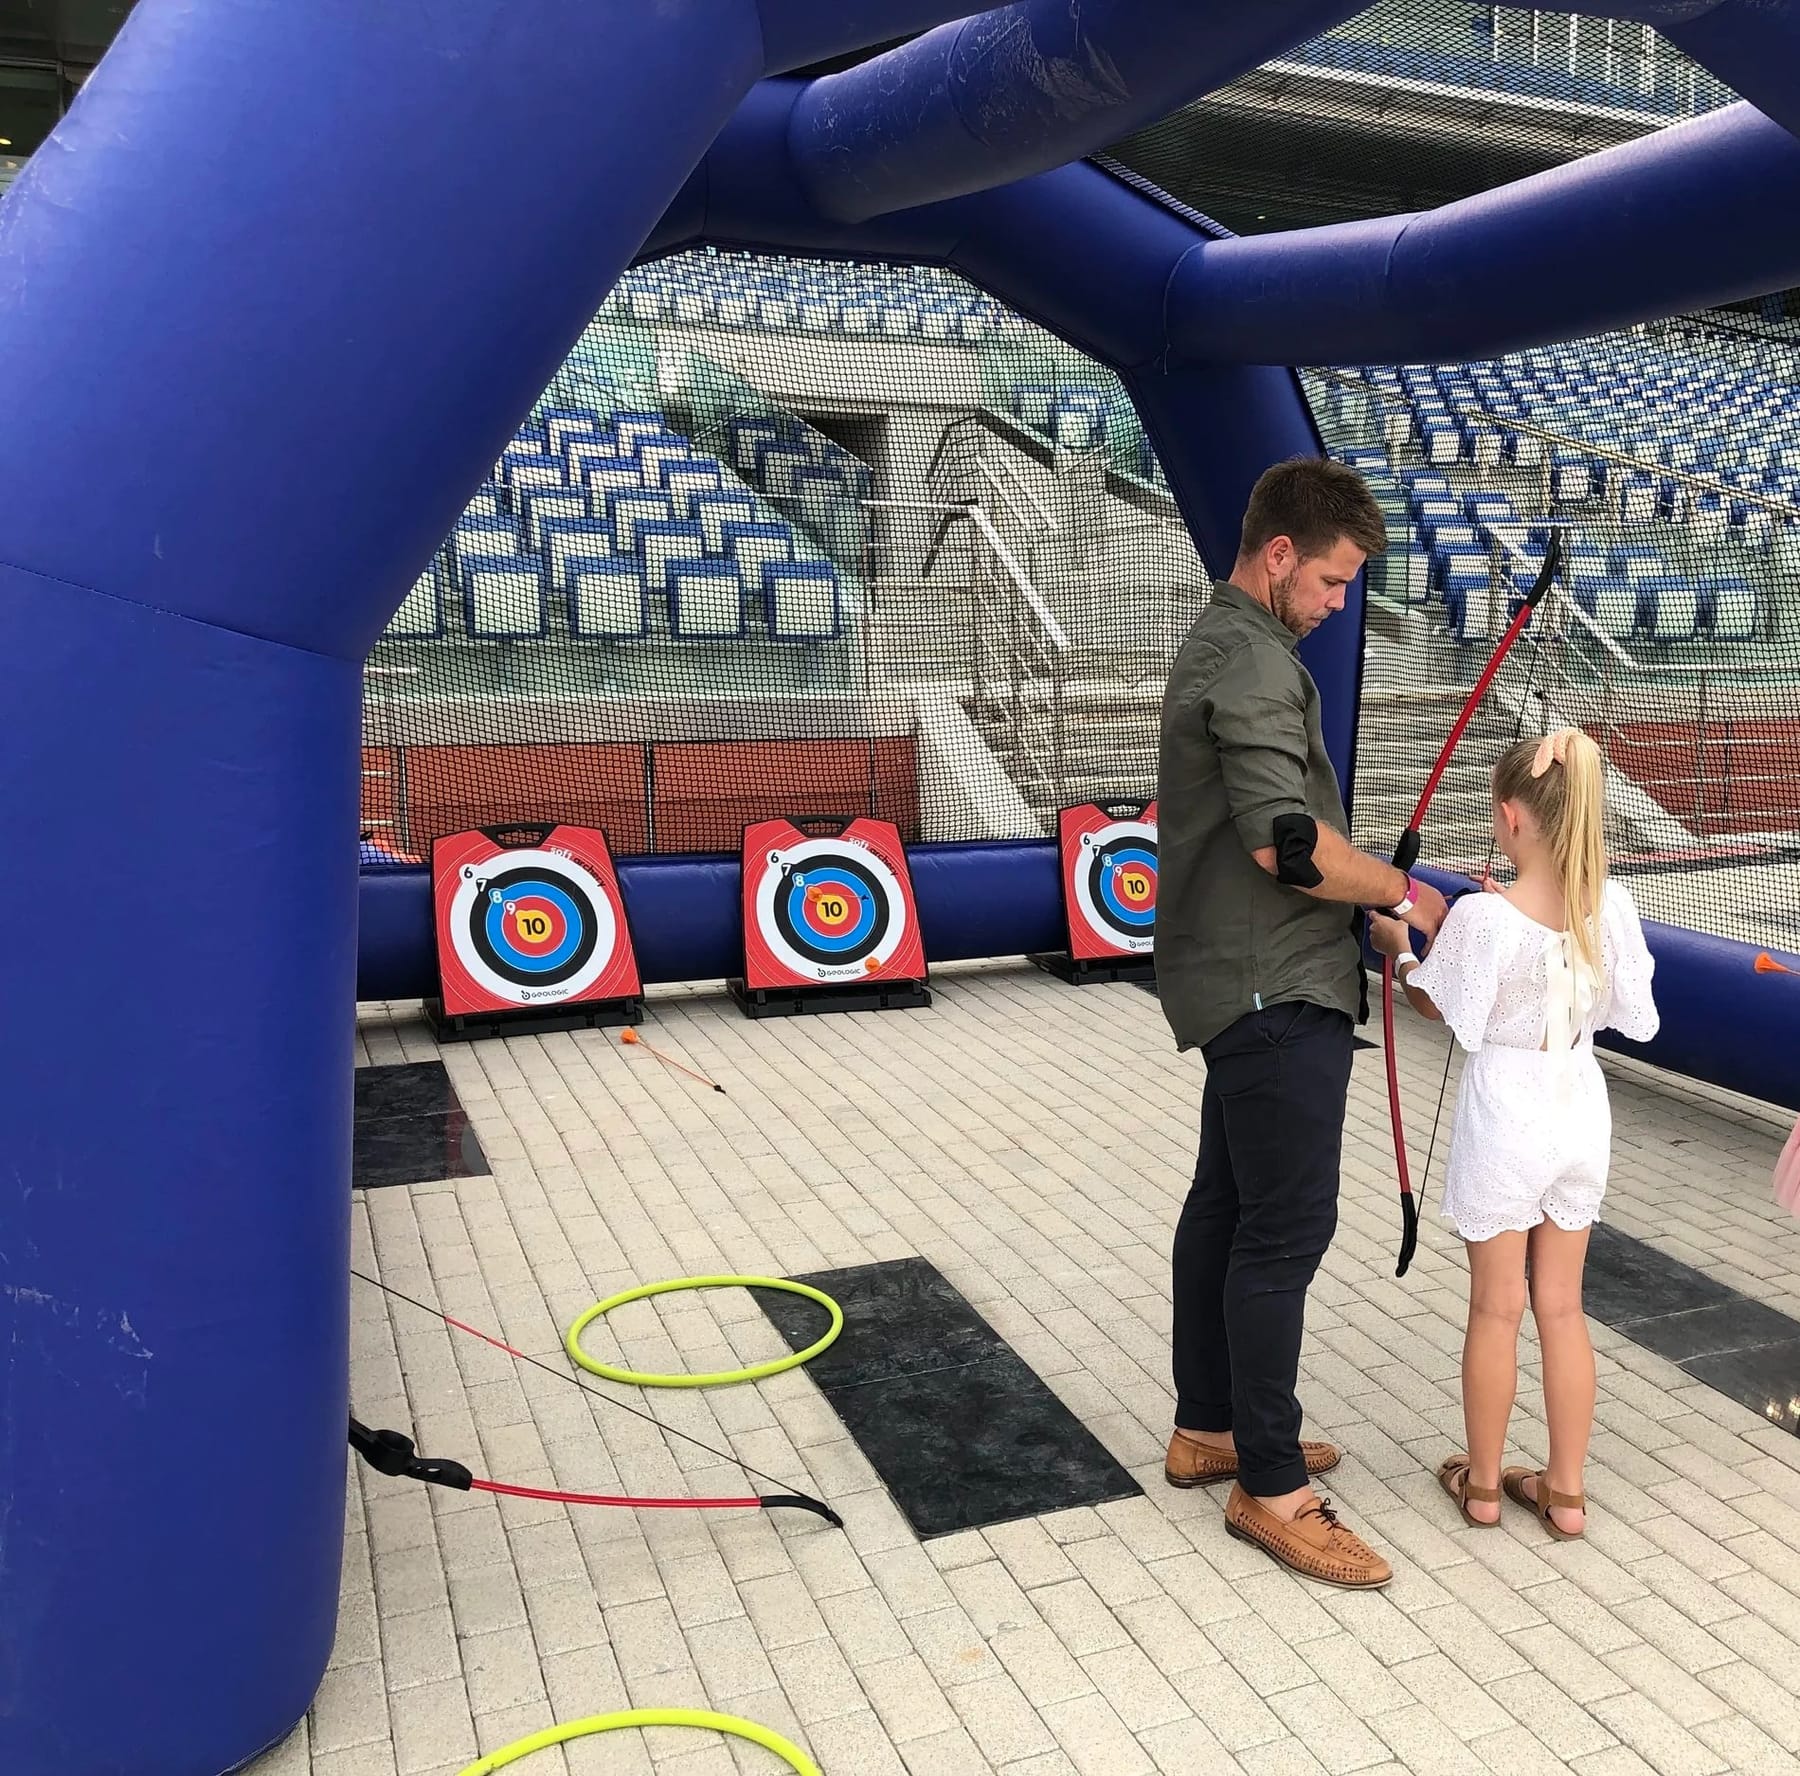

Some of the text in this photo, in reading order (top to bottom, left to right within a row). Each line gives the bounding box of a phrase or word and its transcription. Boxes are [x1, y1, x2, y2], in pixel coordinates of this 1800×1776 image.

[1083, 834, 1091, 845] 6
[770, 852, 779, 863] 6
[849, 837, 898, 876] soft archery
[1094, 846, 1101, 857] 7
[550, 847, 606, 887] soft archery
[1105, 857, 1113, 868] 8
[463, 866, 473, 879] 6
[783, 864, 792, 876] 7
[1115, 866, 1123, 877] 9
[477, 879, 487, 892] 7
[795, 875, 804, 887] 8
[1128, 880, 1145, 895] 10
[492, 891, 502, 903] 8
[506, 902, 516, 915] 9
[822, 901, 842, 917] 10
[522, 917, 545, 935] 10
[531, 989, 569, 998] GEOLOGIC
